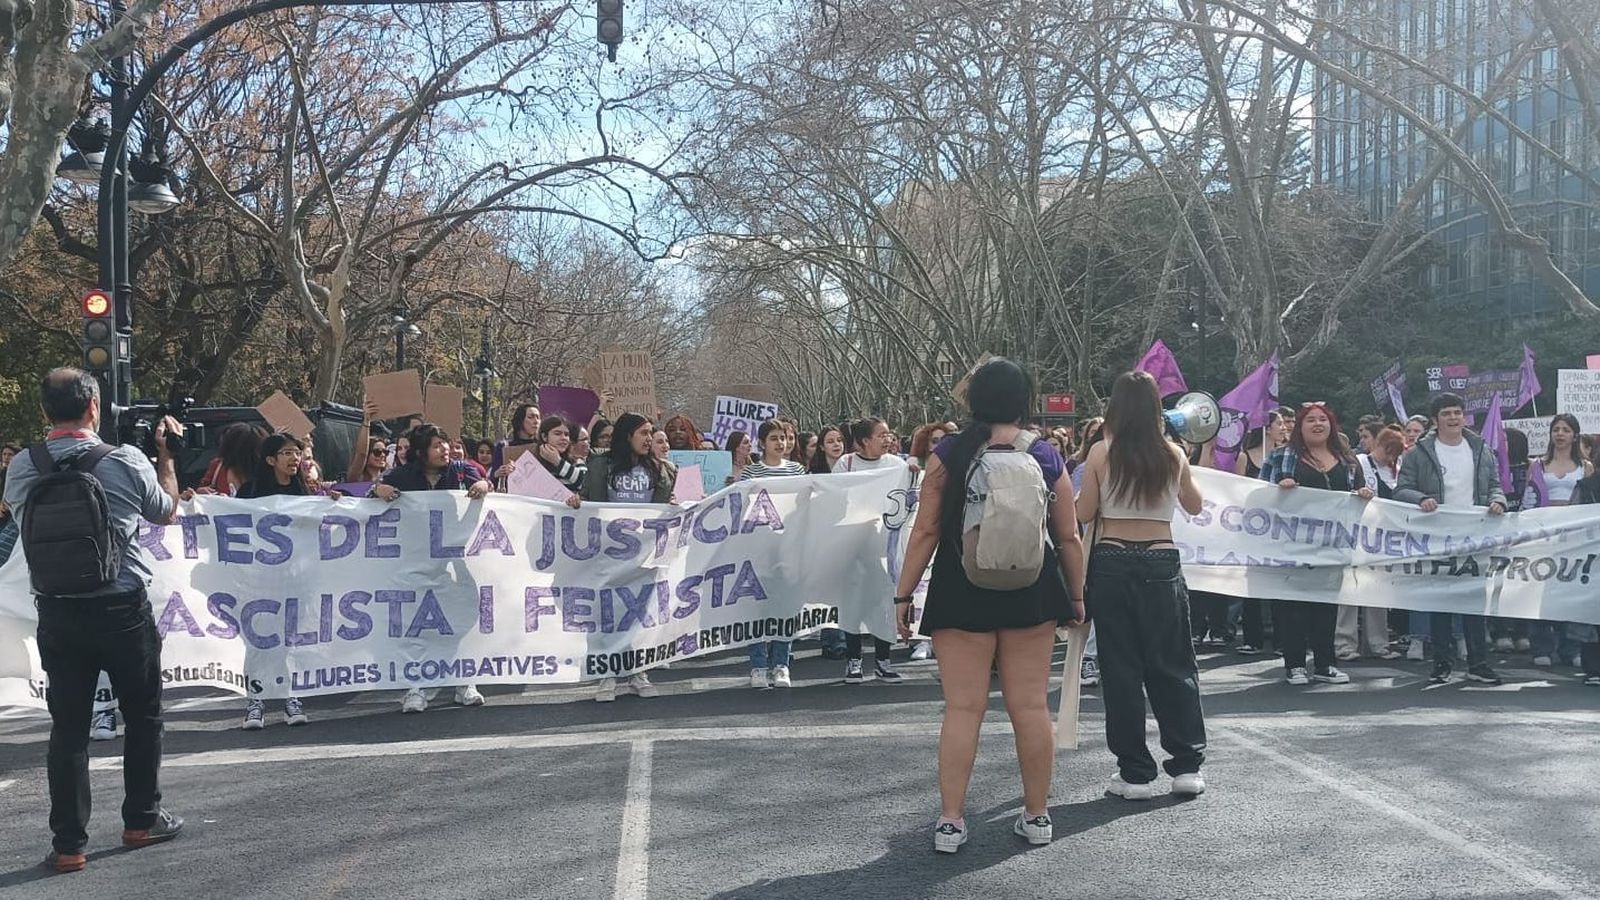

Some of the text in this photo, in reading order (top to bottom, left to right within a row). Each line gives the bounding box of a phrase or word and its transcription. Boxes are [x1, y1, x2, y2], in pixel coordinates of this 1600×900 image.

[1426, 367, 1443, 379] SER
[138, 512, 294, 566] RTES
[429, 509, 516, 559] LA
[535, 488, 785, 571] JUSTICIA
[1219, 504, 1431, 557] CONTINUEN
[1486, 553, 1598, 585] PROU!
[157, 559, 768, 650] ASCLISTA I FEIXISTA
[586, 606, 840, 676] ESQUERRA REVOLUCIONÀRIA
[291, 663, 382, 691] LLIURES
[403, 655, 559, 682] COMBATIVES
